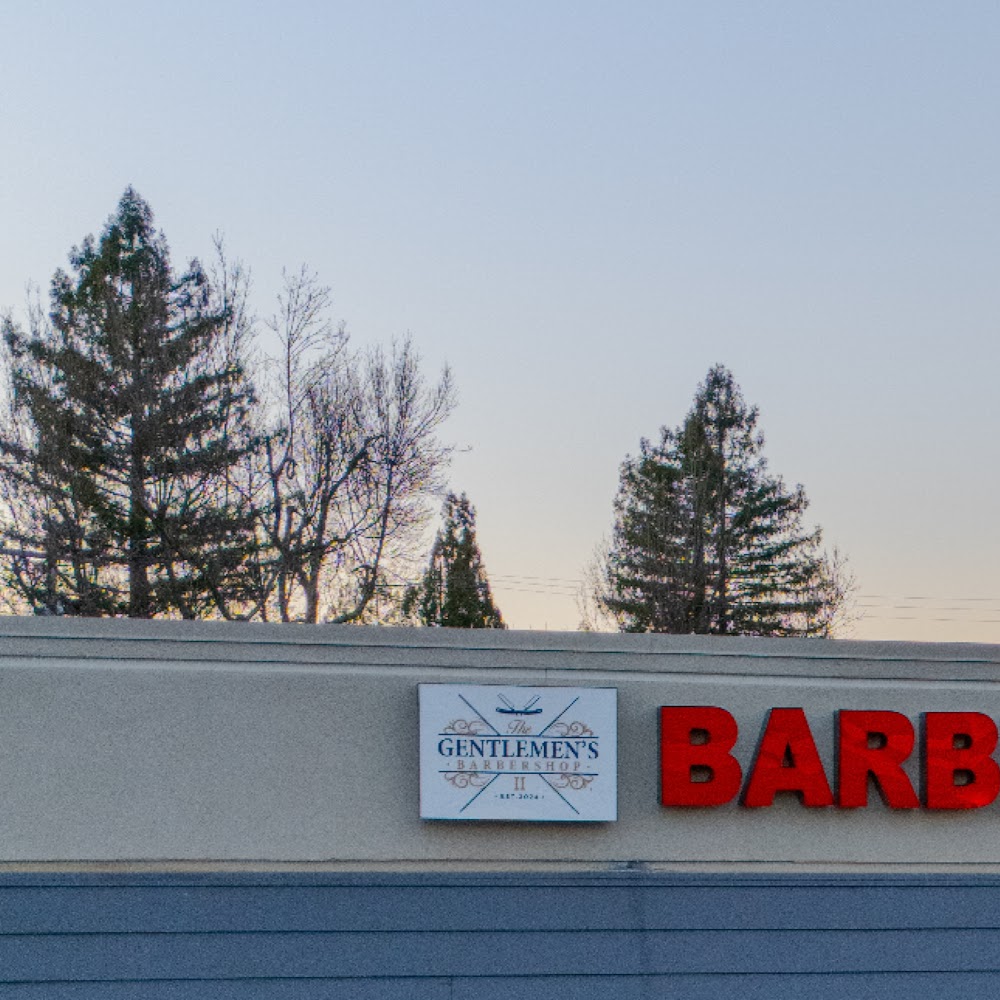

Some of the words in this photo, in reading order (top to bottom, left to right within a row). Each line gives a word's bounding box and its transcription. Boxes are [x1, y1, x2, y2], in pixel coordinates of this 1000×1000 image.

[506, 719, 532, 735] The
[437, 738, 599, 760] GENTLEMEN'S
[456, 759, 582, 771] BARBERSHOP
